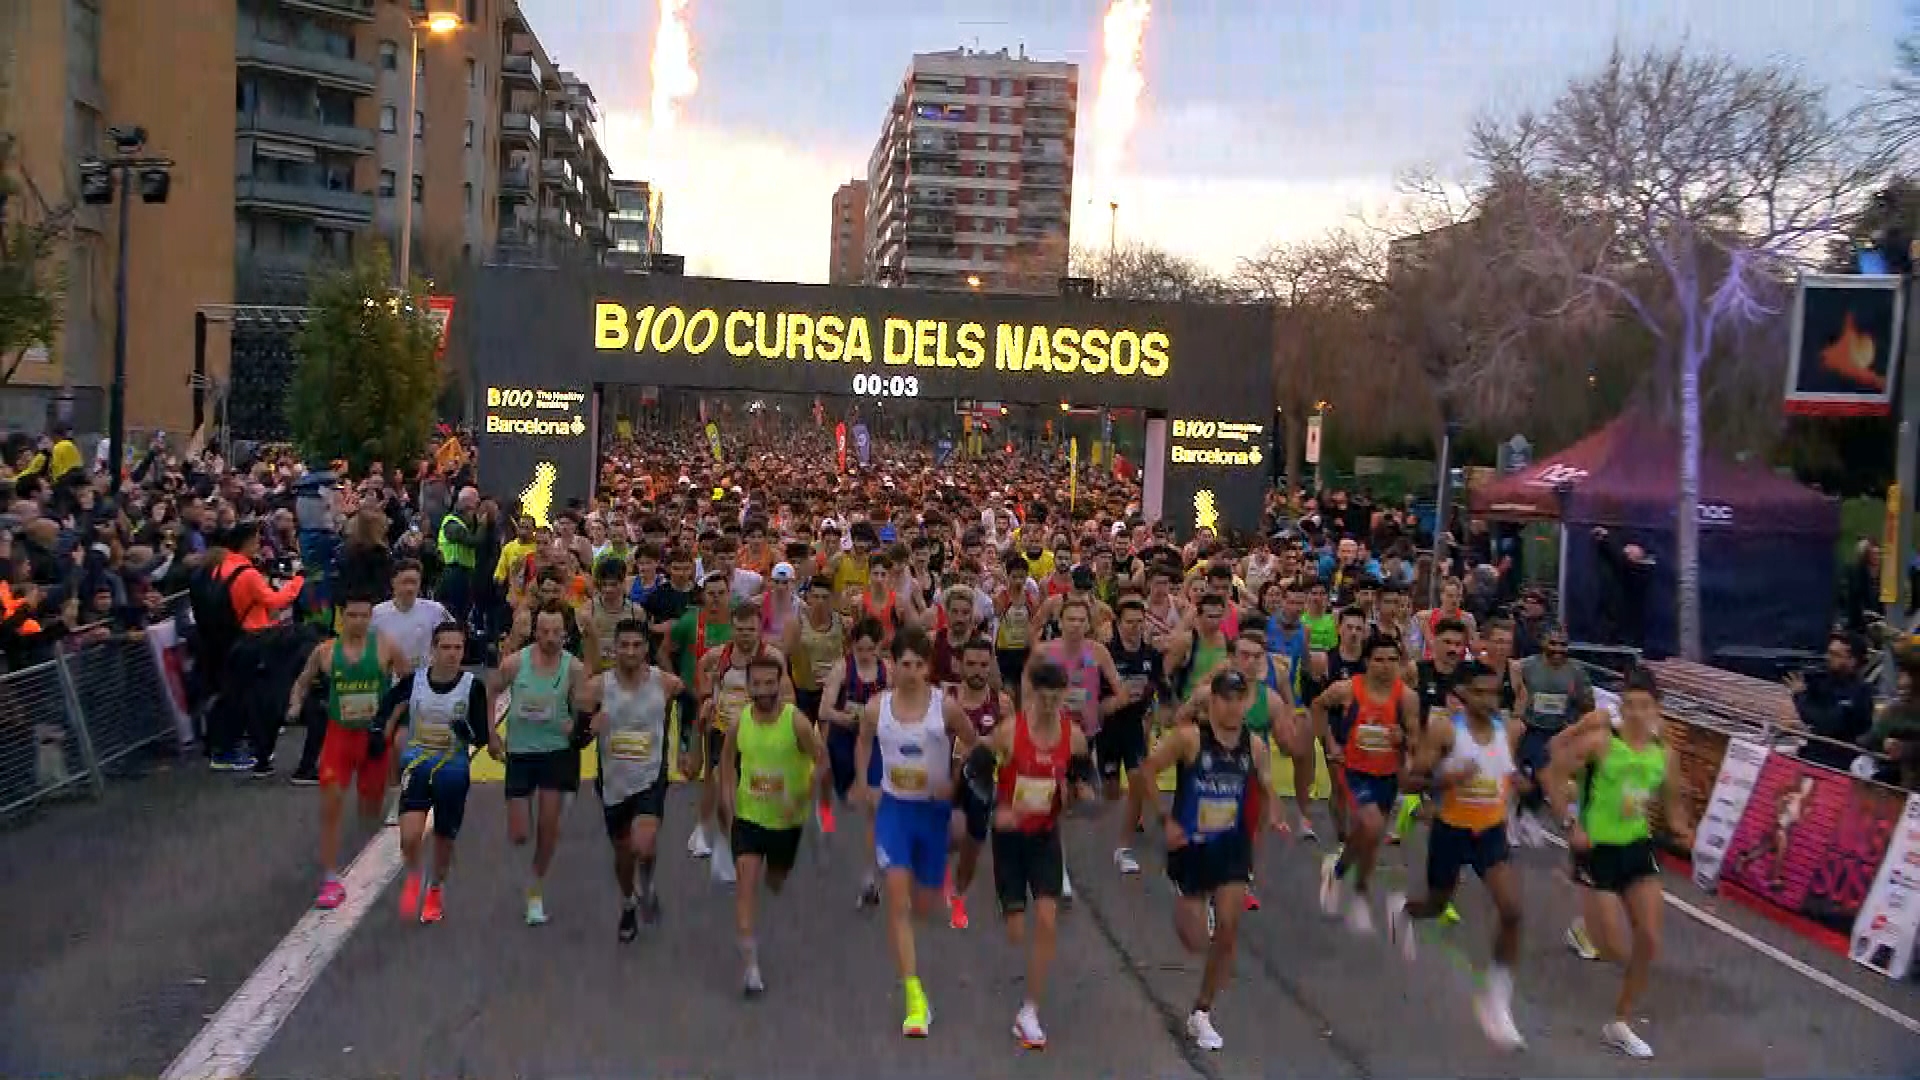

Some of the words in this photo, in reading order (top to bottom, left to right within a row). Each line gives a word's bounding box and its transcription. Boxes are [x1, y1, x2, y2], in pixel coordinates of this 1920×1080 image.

[595, 303, 718, 354] B100
[724, 310, 872, 363] CURSA
[883, 318, 985, 369] DELS
[995, 323, 1169, 377] NASSOS
[852, 373, 918, 396] 00:03
[487, 387, 534, 409] B100
[486, 415, 569, 435] Barcelona
[1172, 420, 1216, 439] B100
[1171, 446, 1248, 465] Barcelona
